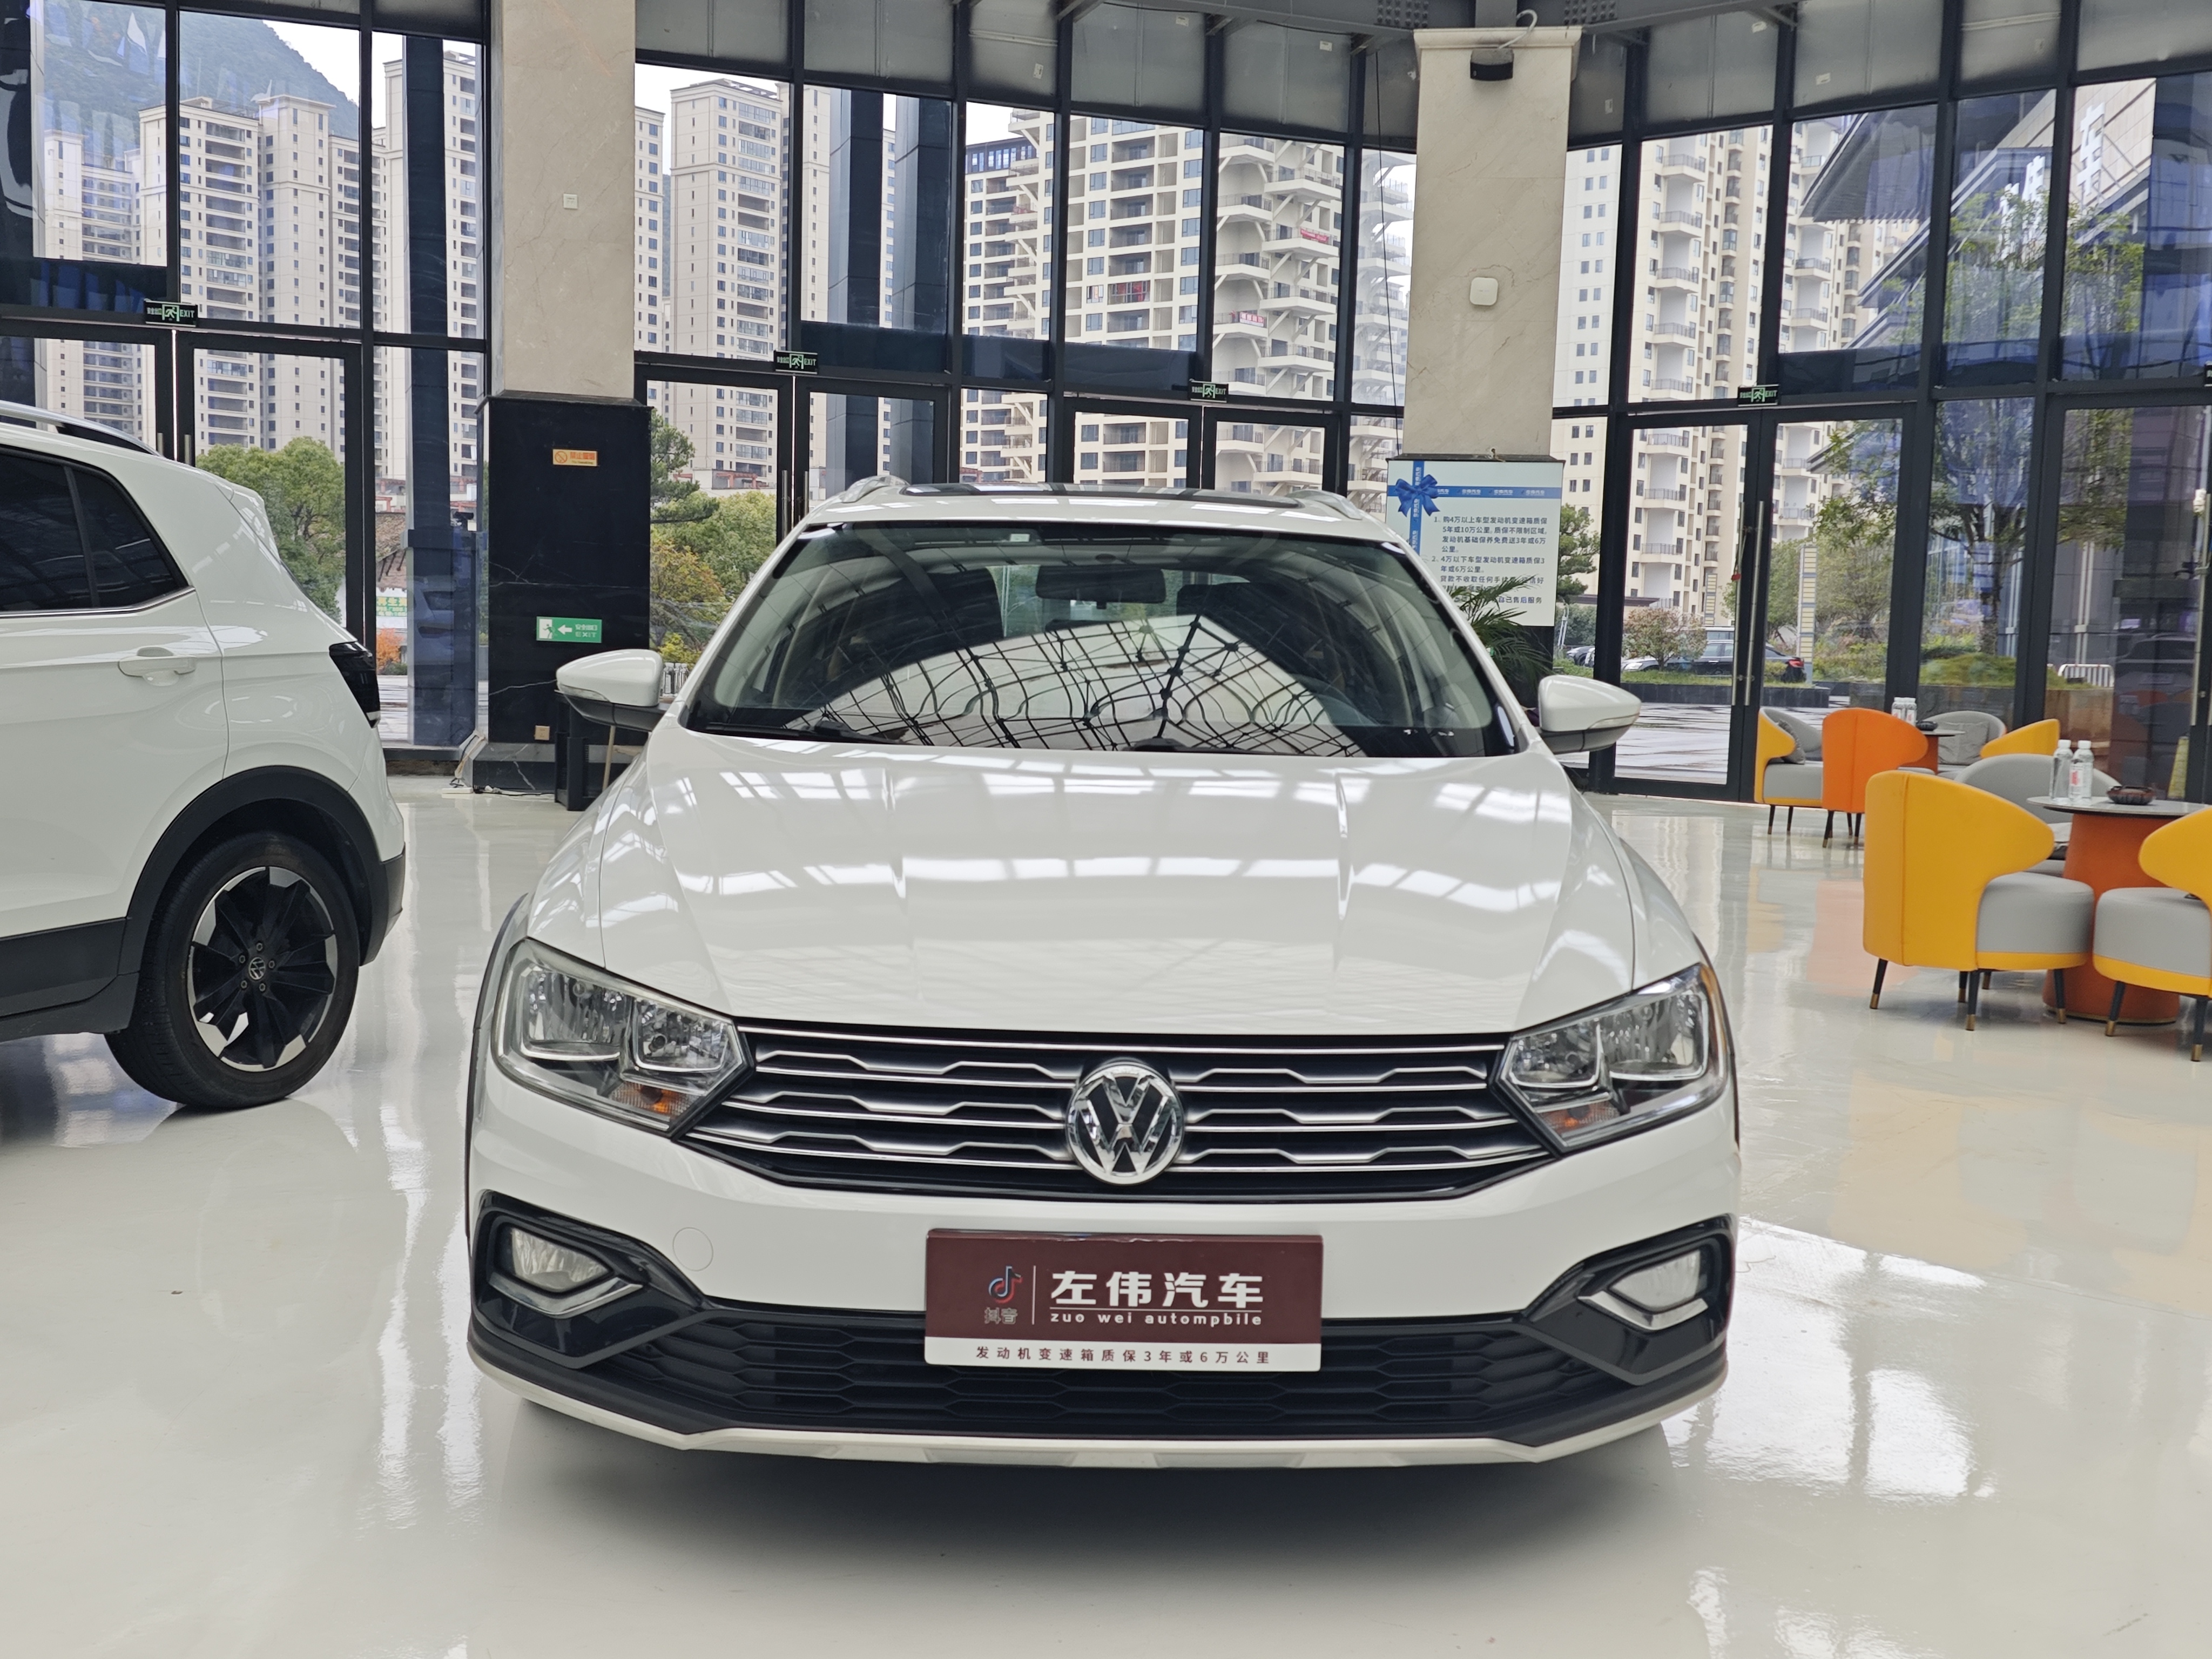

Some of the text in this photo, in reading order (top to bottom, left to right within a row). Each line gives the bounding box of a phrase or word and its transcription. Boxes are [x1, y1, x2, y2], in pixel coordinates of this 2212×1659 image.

[180, 309, 194, 318] EXIT
[1051, 1270, 1263, 1309] 左伟汽车
[984, 1307, 1018, 1325] 抖音
[1050, 1313, 1085, 1323] zuo
[1097, 1312, 1132, 1324] wei
[976, 1346, 1270, 1364] 发动机变速箱质保3年或6万公里
